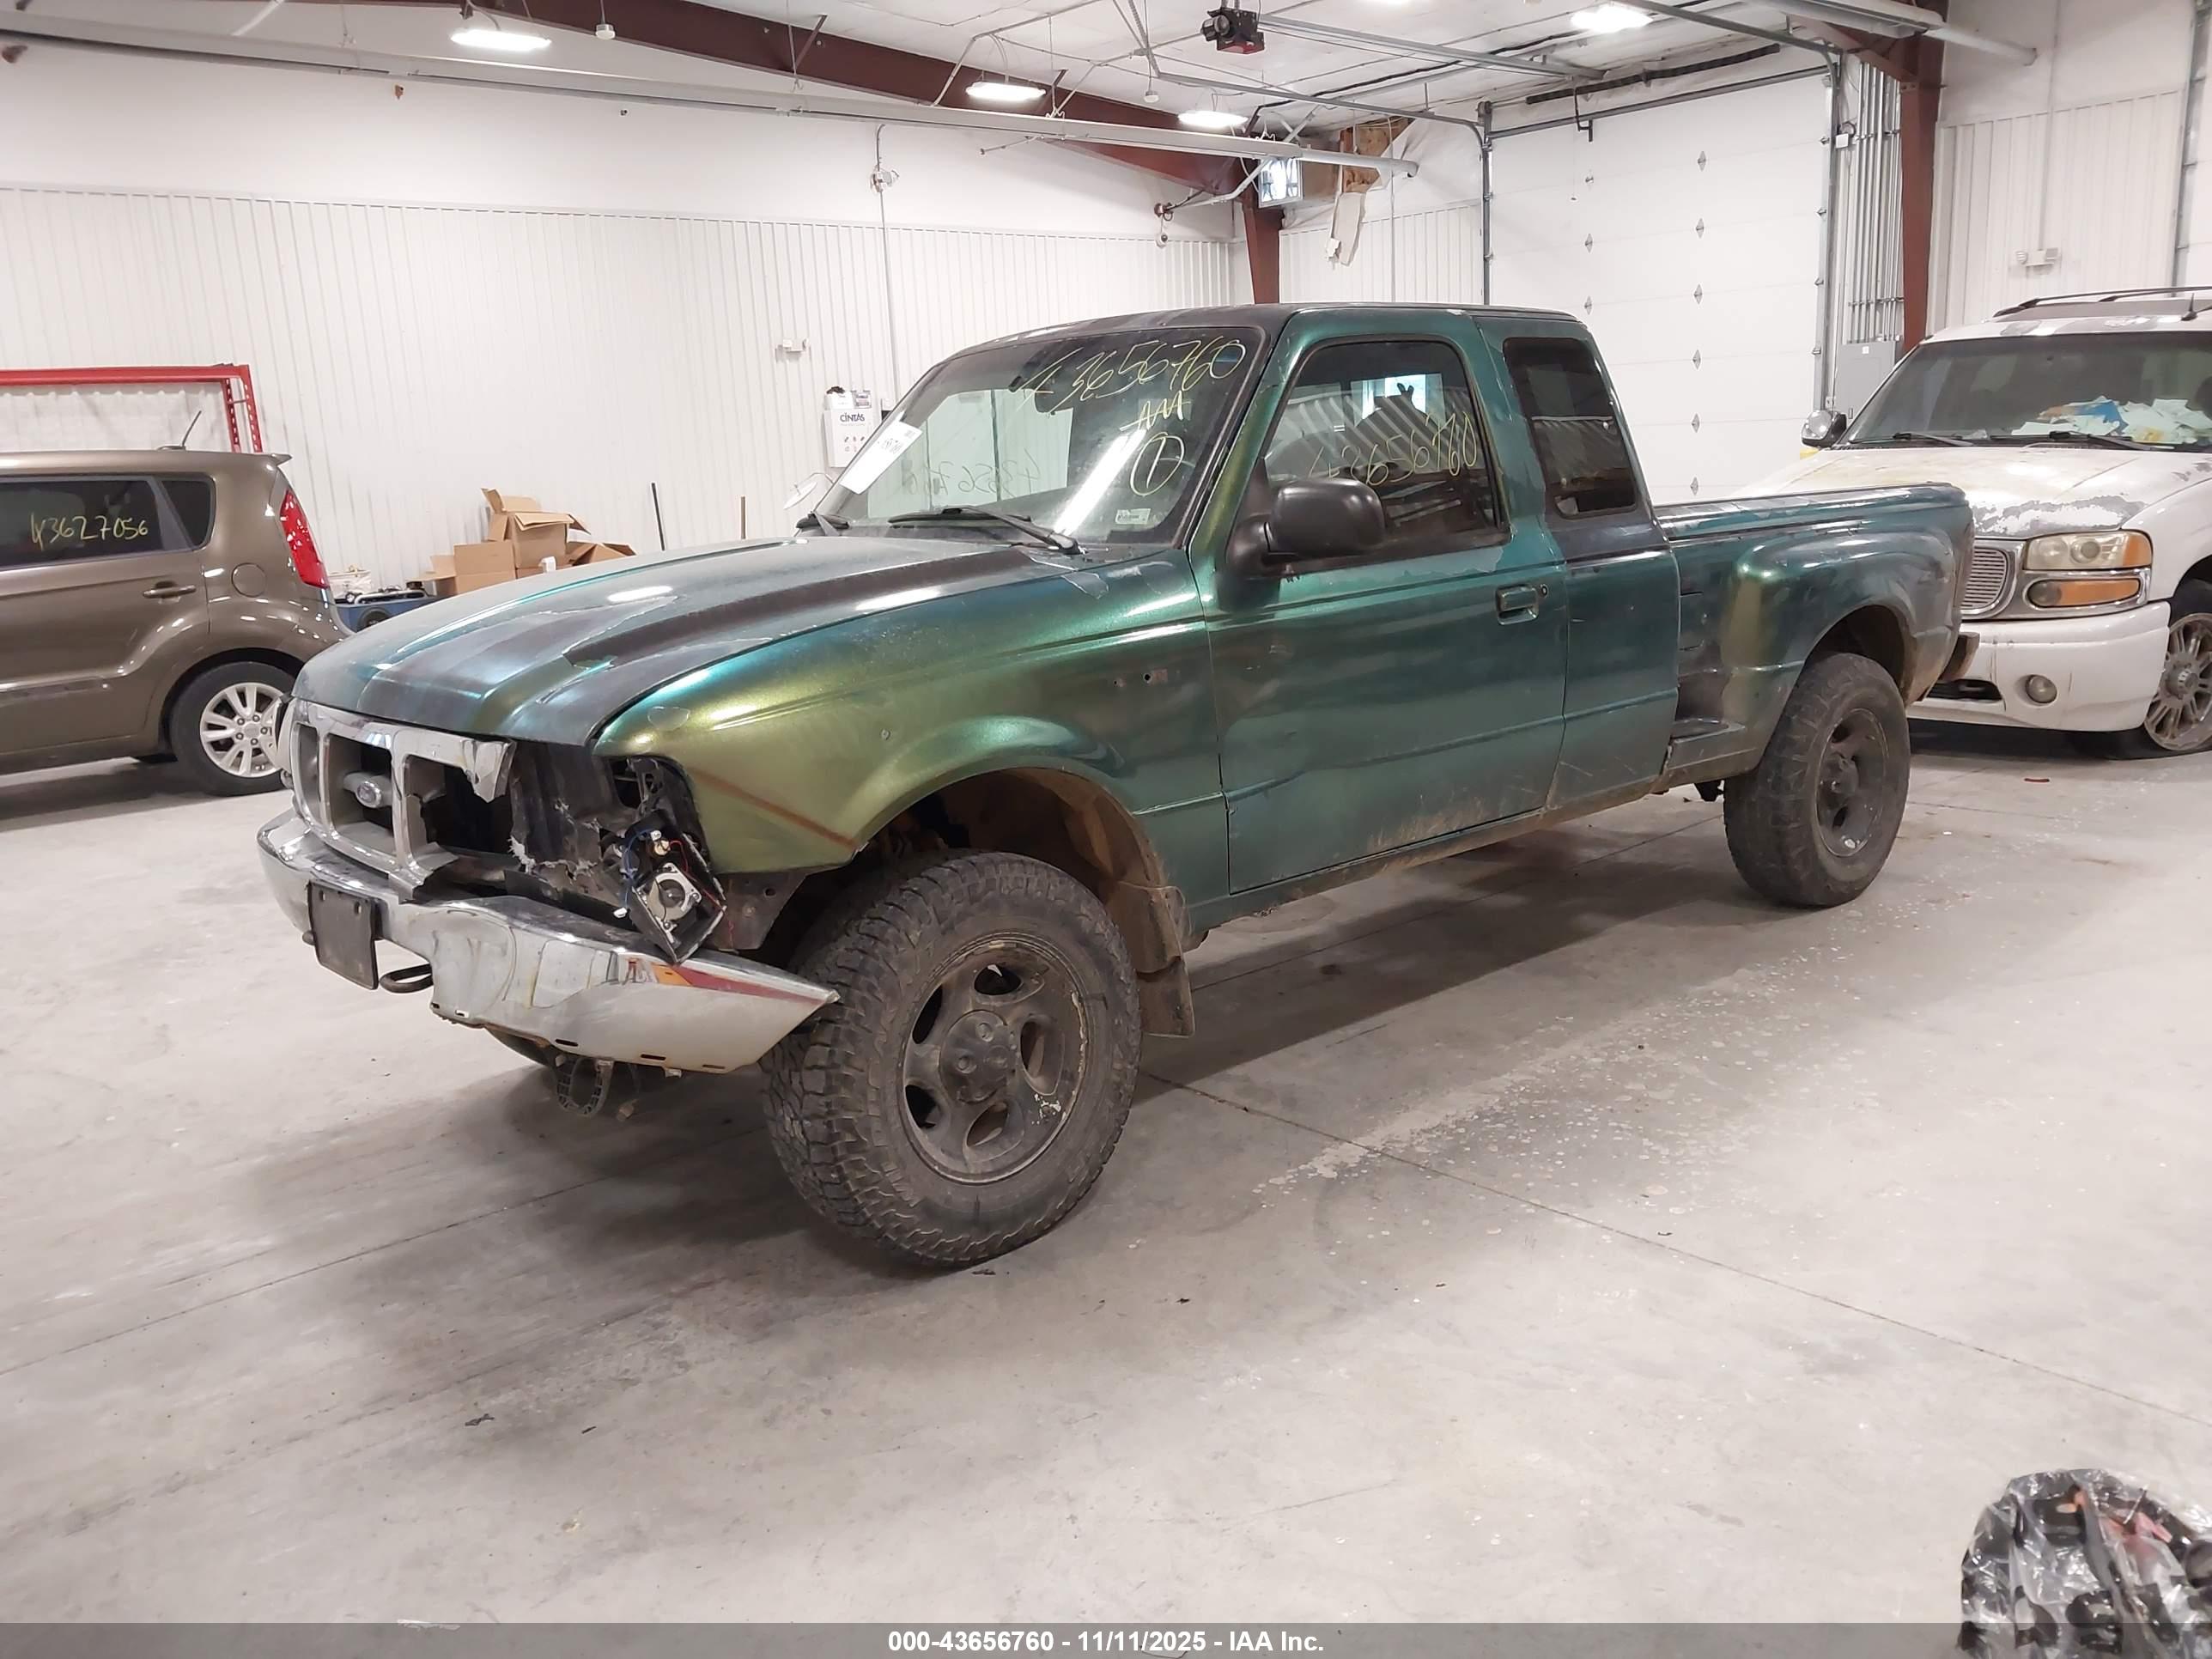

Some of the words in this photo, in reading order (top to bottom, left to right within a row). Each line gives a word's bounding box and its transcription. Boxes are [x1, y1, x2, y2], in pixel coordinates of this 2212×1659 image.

[1016, 336, 1246, 414] 43656760
[839, 412, 866, 422] CINTAS
[30, 512, 149, 550] 43627056
